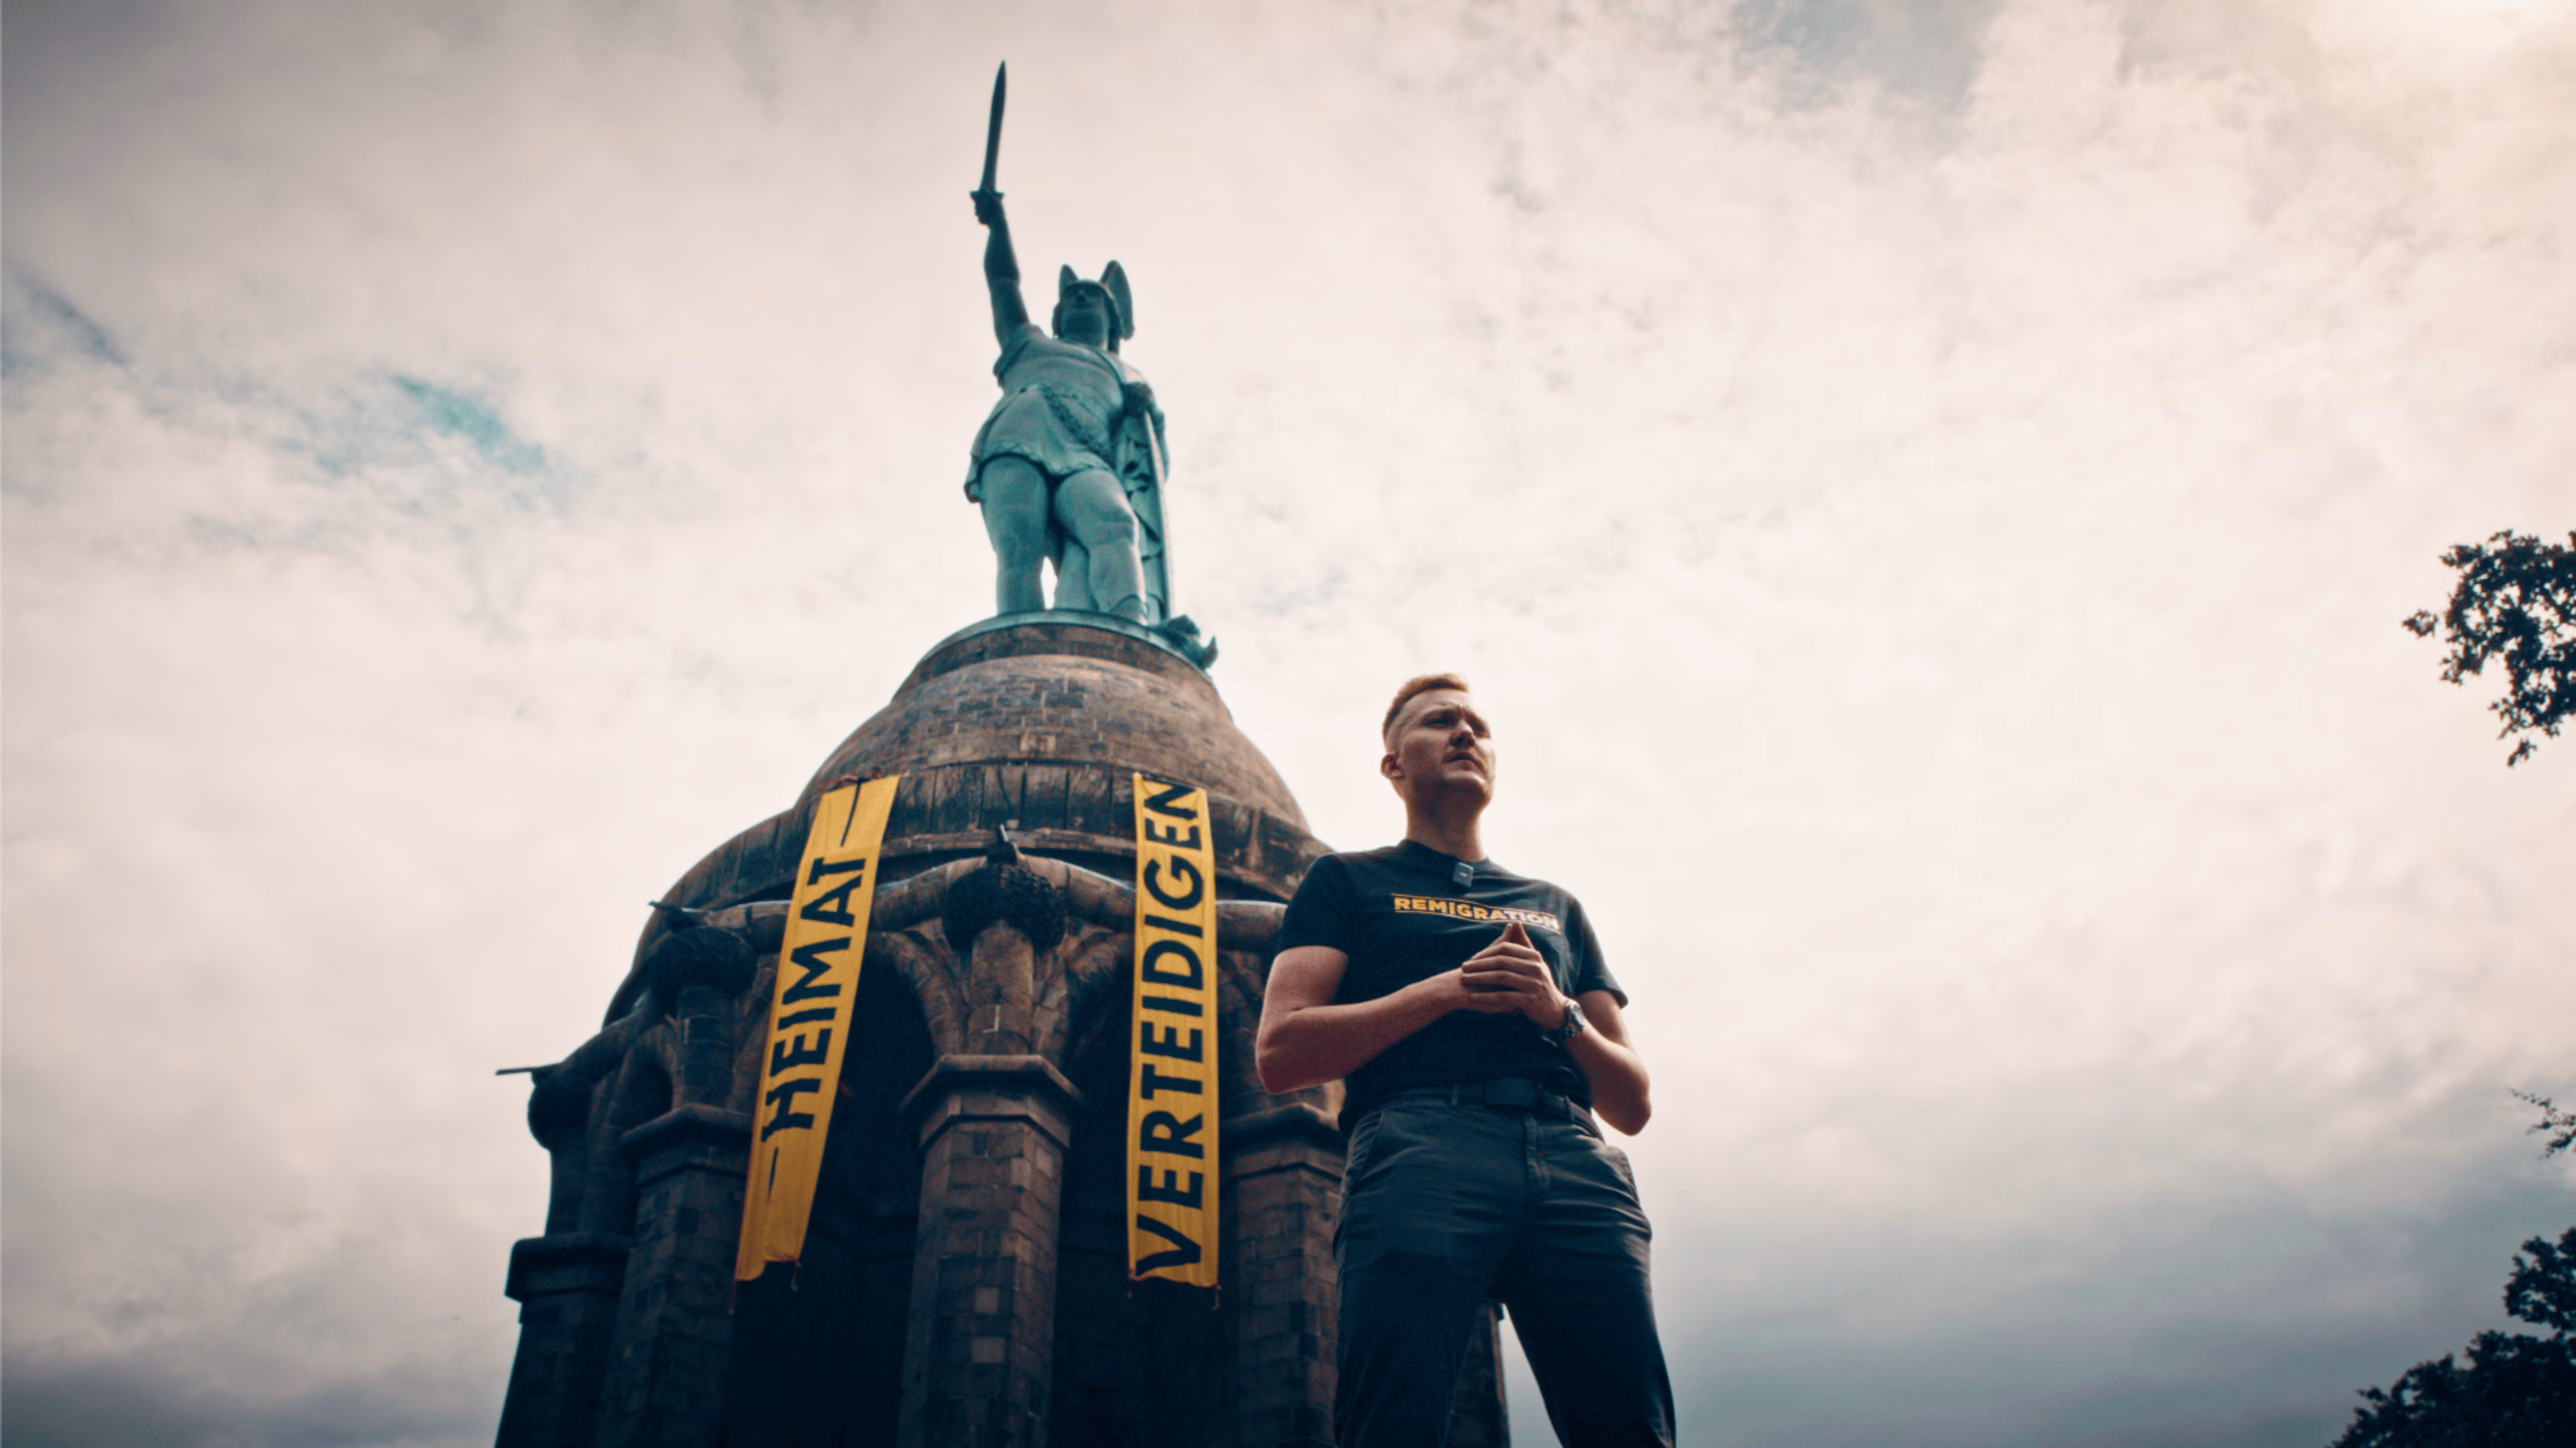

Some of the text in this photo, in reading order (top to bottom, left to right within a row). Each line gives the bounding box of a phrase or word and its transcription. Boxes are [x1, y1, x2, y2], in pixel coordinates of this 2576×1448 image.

[760, 856, 866, 1143] HEIMAT
[1135, 782, 1204, 1276] VERTEIDIGEN
[1393, 896, 1560, 930] REMIGRATION
